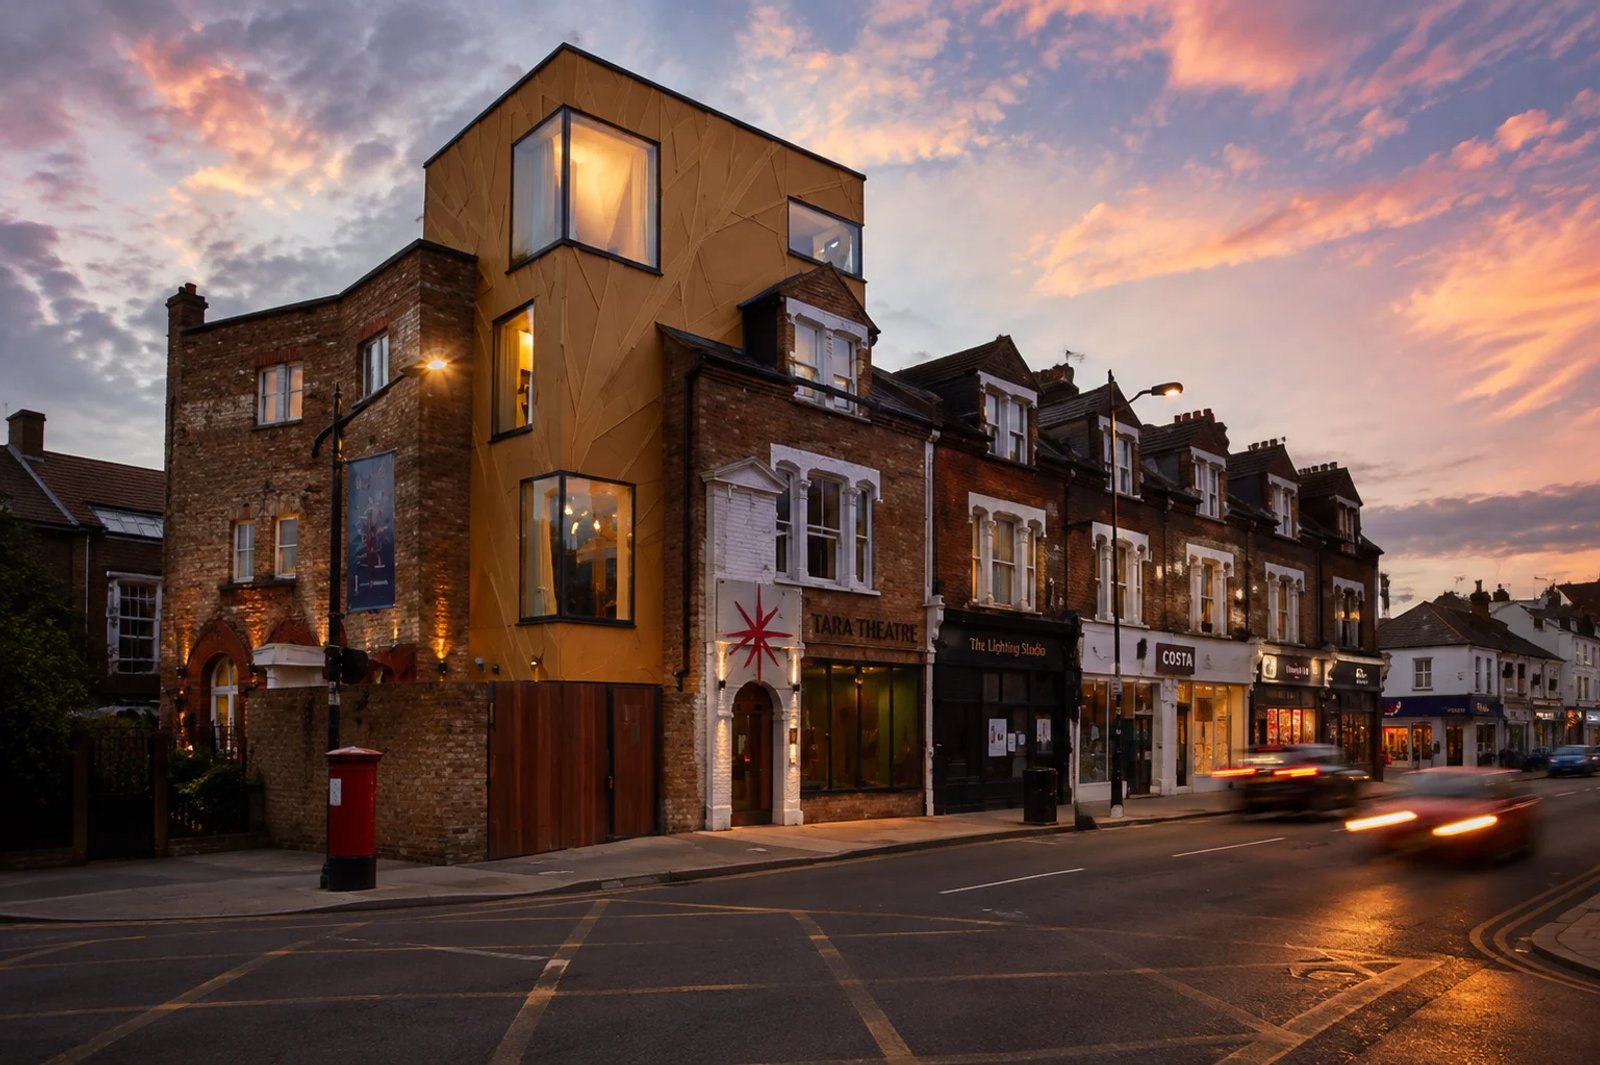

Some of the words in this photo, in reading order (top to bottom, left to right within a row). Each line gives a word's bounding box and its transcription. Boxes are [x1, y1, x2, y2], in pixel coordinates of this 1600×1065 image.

[811, 613, 853, 636] TARA
[856, 618, 918, 643] THEATRE
[969, 637, 985, 651] The
[988, 639, 1020, 657] Lighting
[1021, 642, 1046, 656] Studio
[1162, 650, 1193, 667] COSTA
